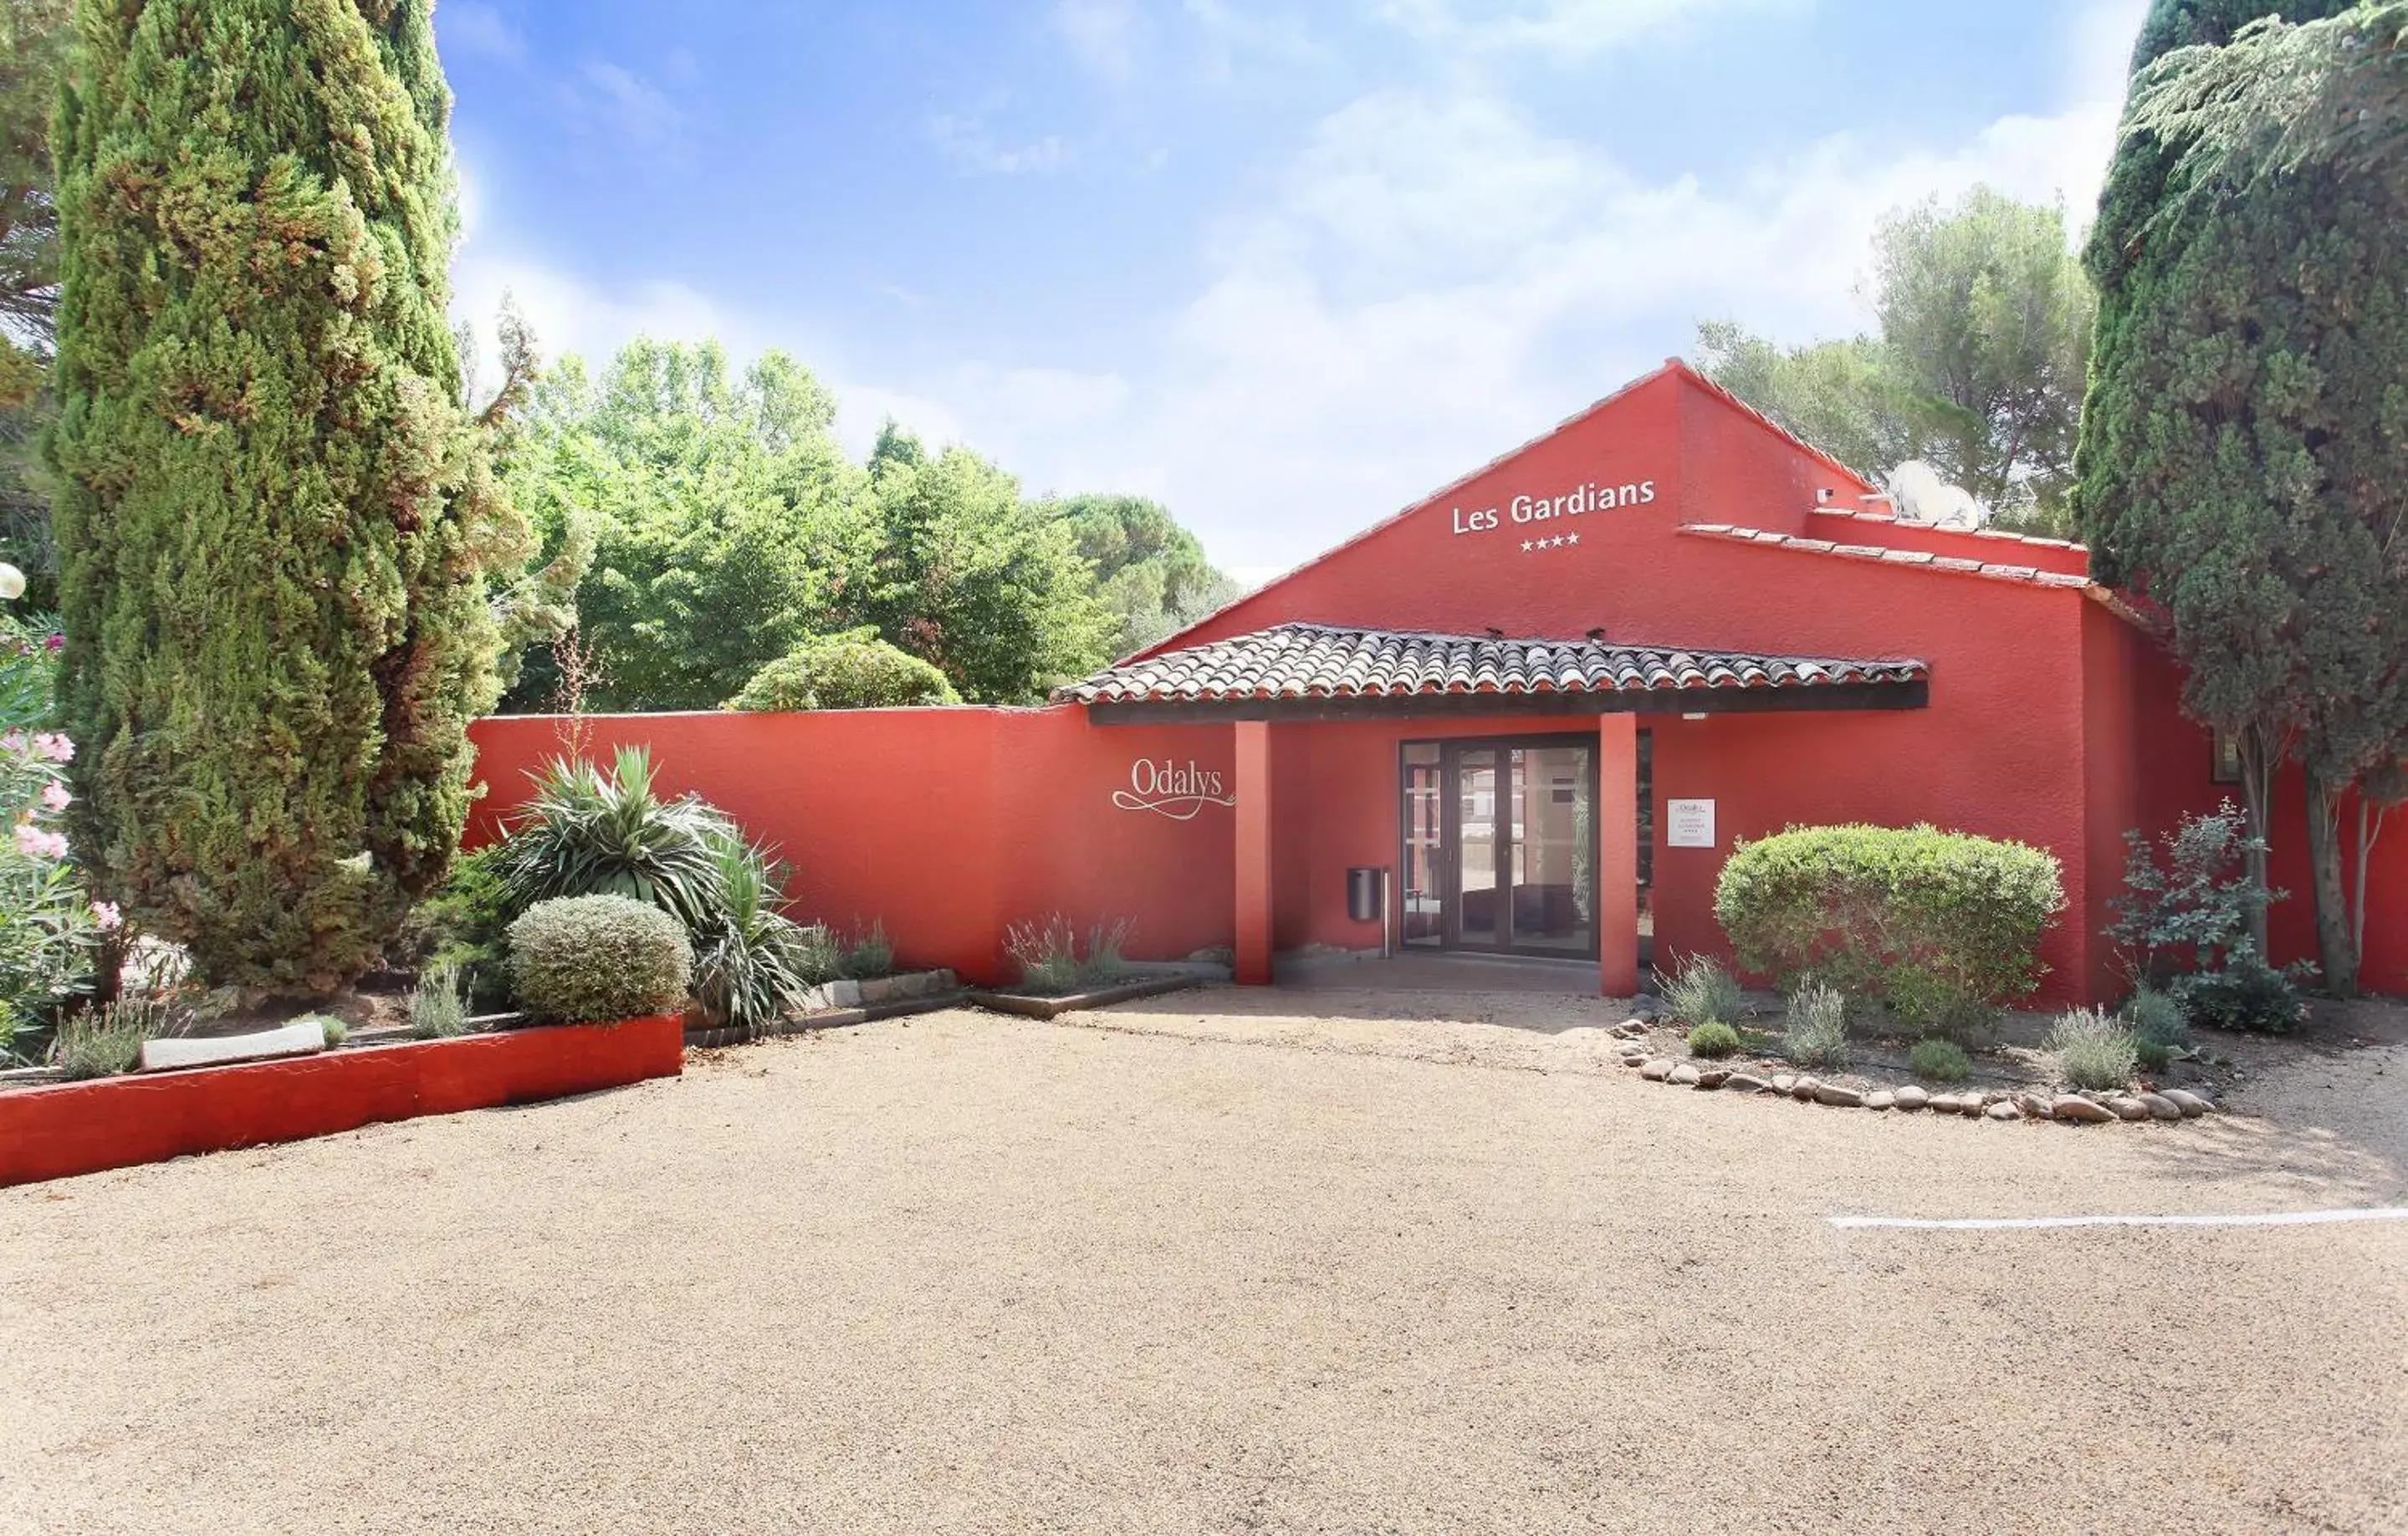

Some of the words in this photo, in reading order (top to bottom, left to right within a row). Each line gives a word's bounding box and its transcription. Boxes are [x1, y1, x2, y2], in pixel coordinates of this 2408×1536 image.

[1453, 507, 1498, 534] Les
[1511, 480, 1654, 523] Gardians
[1131, 758, 1222, 819] Odalys
